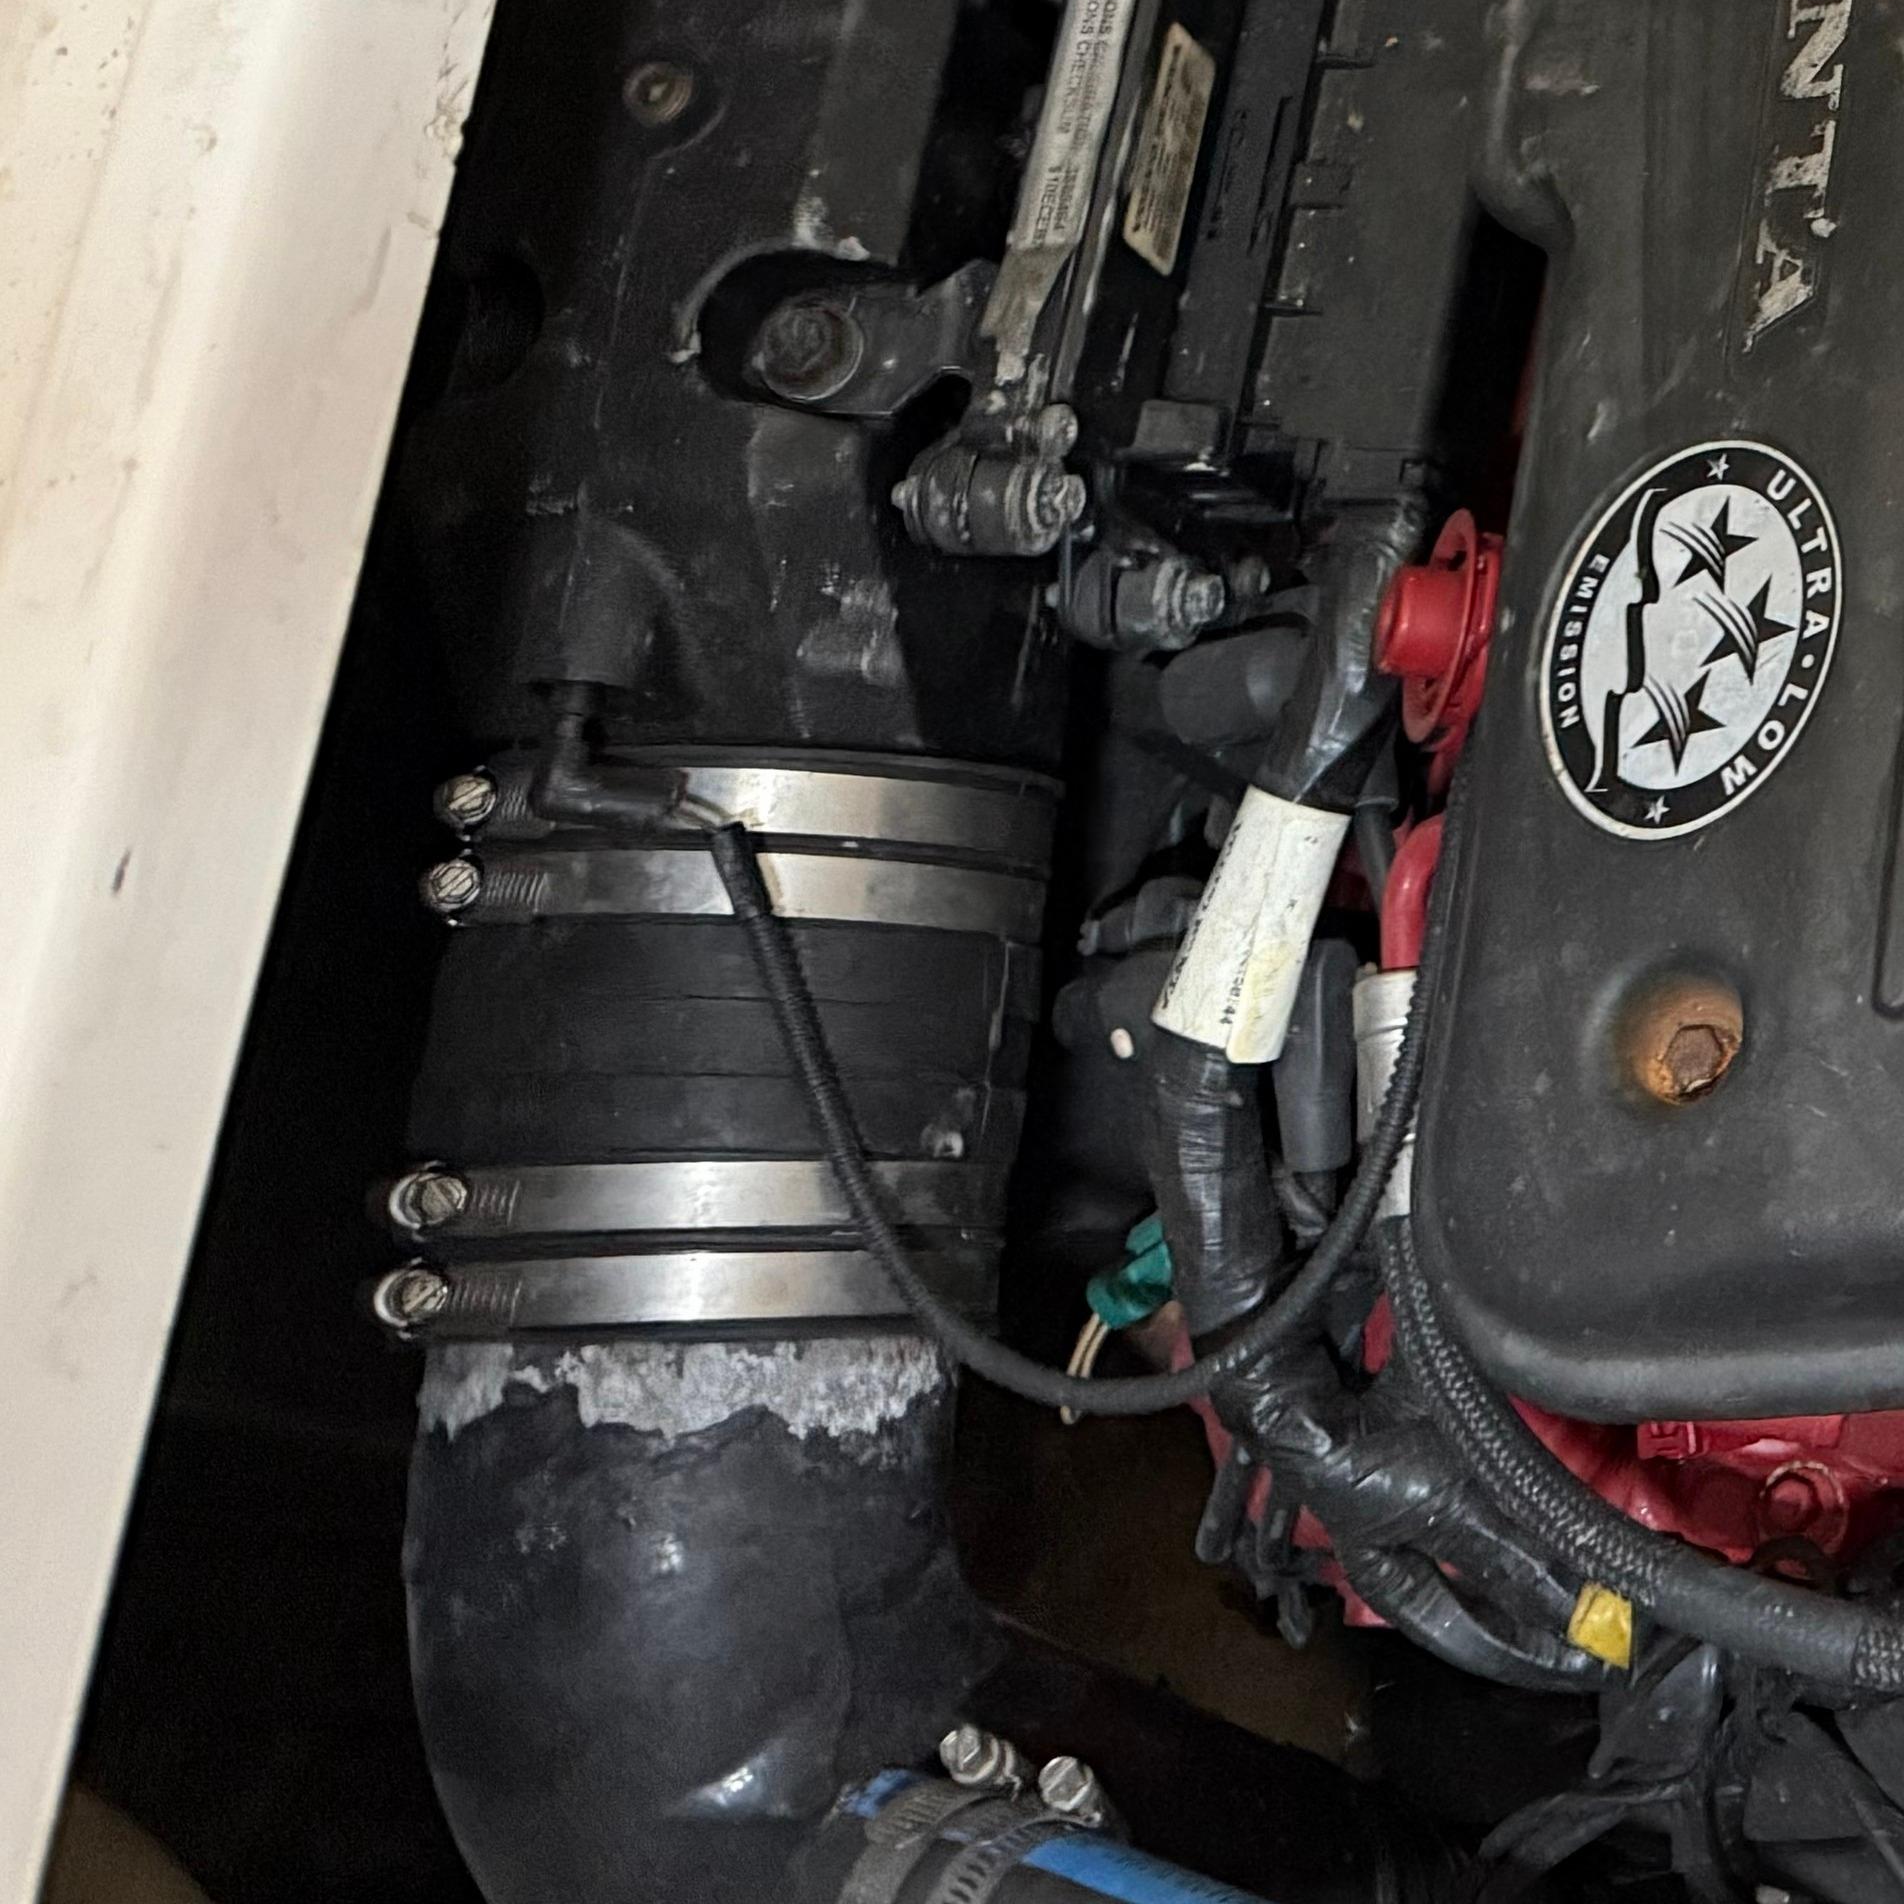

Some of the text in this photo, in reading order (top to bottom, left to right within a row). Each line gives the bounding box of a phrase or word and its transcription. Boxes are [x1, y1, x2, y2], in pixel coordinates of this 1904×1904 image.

[1056, 40, 1089, 136] CHECKSUM
[1556, 553, 1611, 729] EMISSION
[1720, 468, 1831, 796] ULTRA LOW
